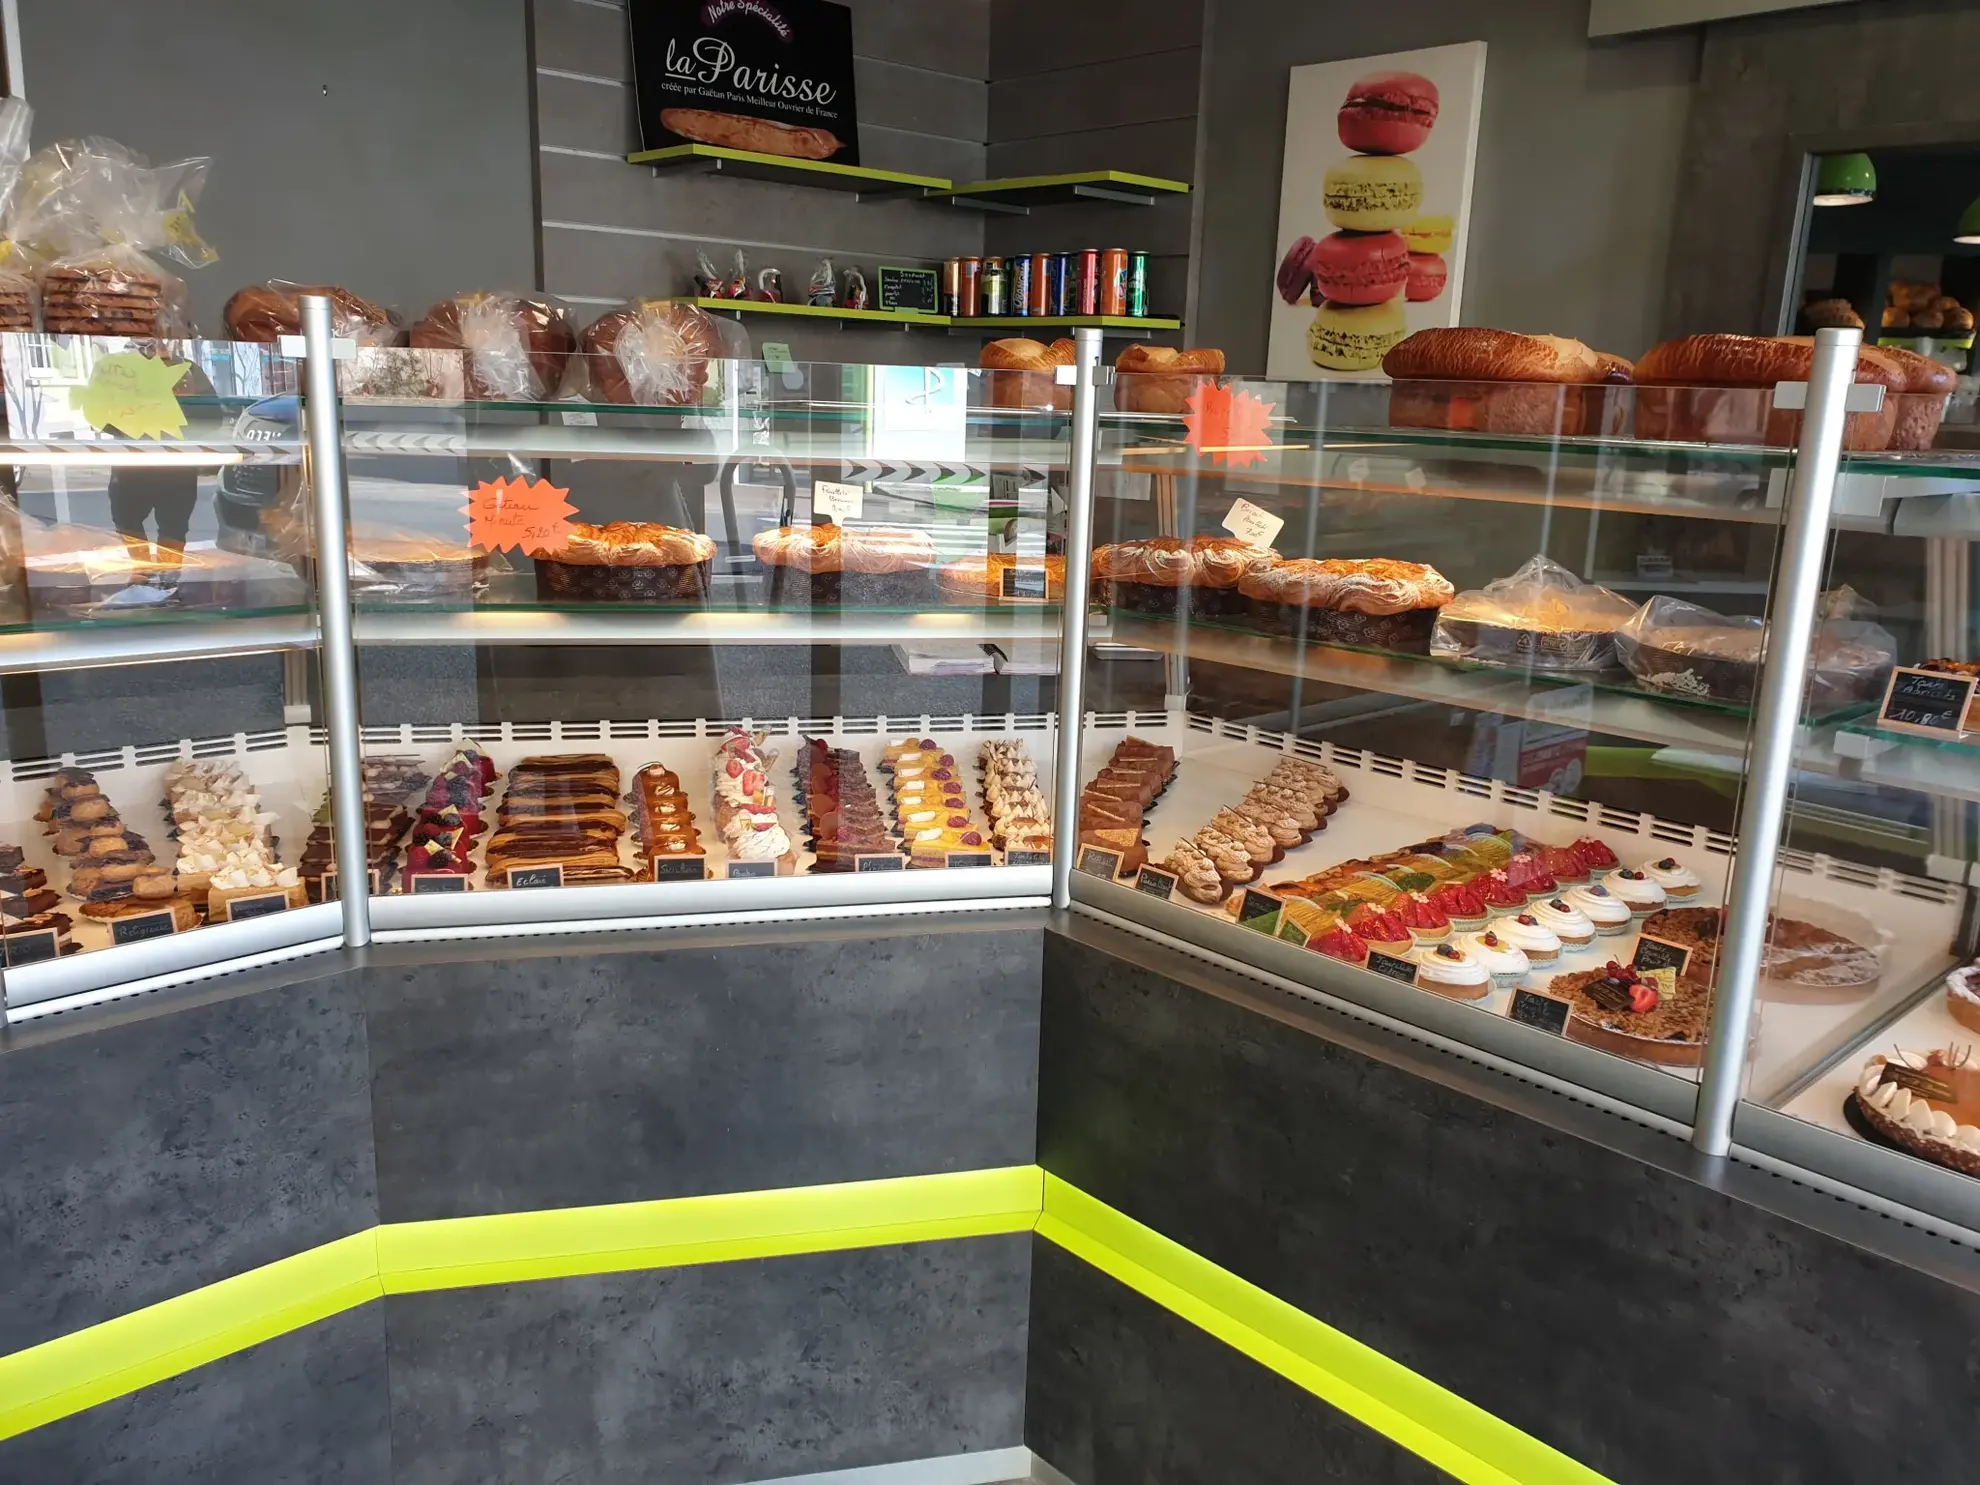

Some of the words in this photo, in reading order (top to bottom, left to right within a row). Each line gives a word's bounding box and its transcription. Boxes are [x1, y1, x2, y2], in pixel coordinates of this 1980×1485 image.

[708, 1, 735, 23] Notre
[665, 38, 697, 75] la
[693, 37, 837, 105] Parisse
[661, 82, 682, 93] créée
[683, 86, 697, 96] par
[698, 86, 725, 100] Gaëtan
[726, 91, 745, 102] Paris
[745, 95, 776, 109] Meilleur
[777, 101, 804, 113] Ouvrier
[805, 105, 814, 115] de
[815, 107, 838, 119] France
